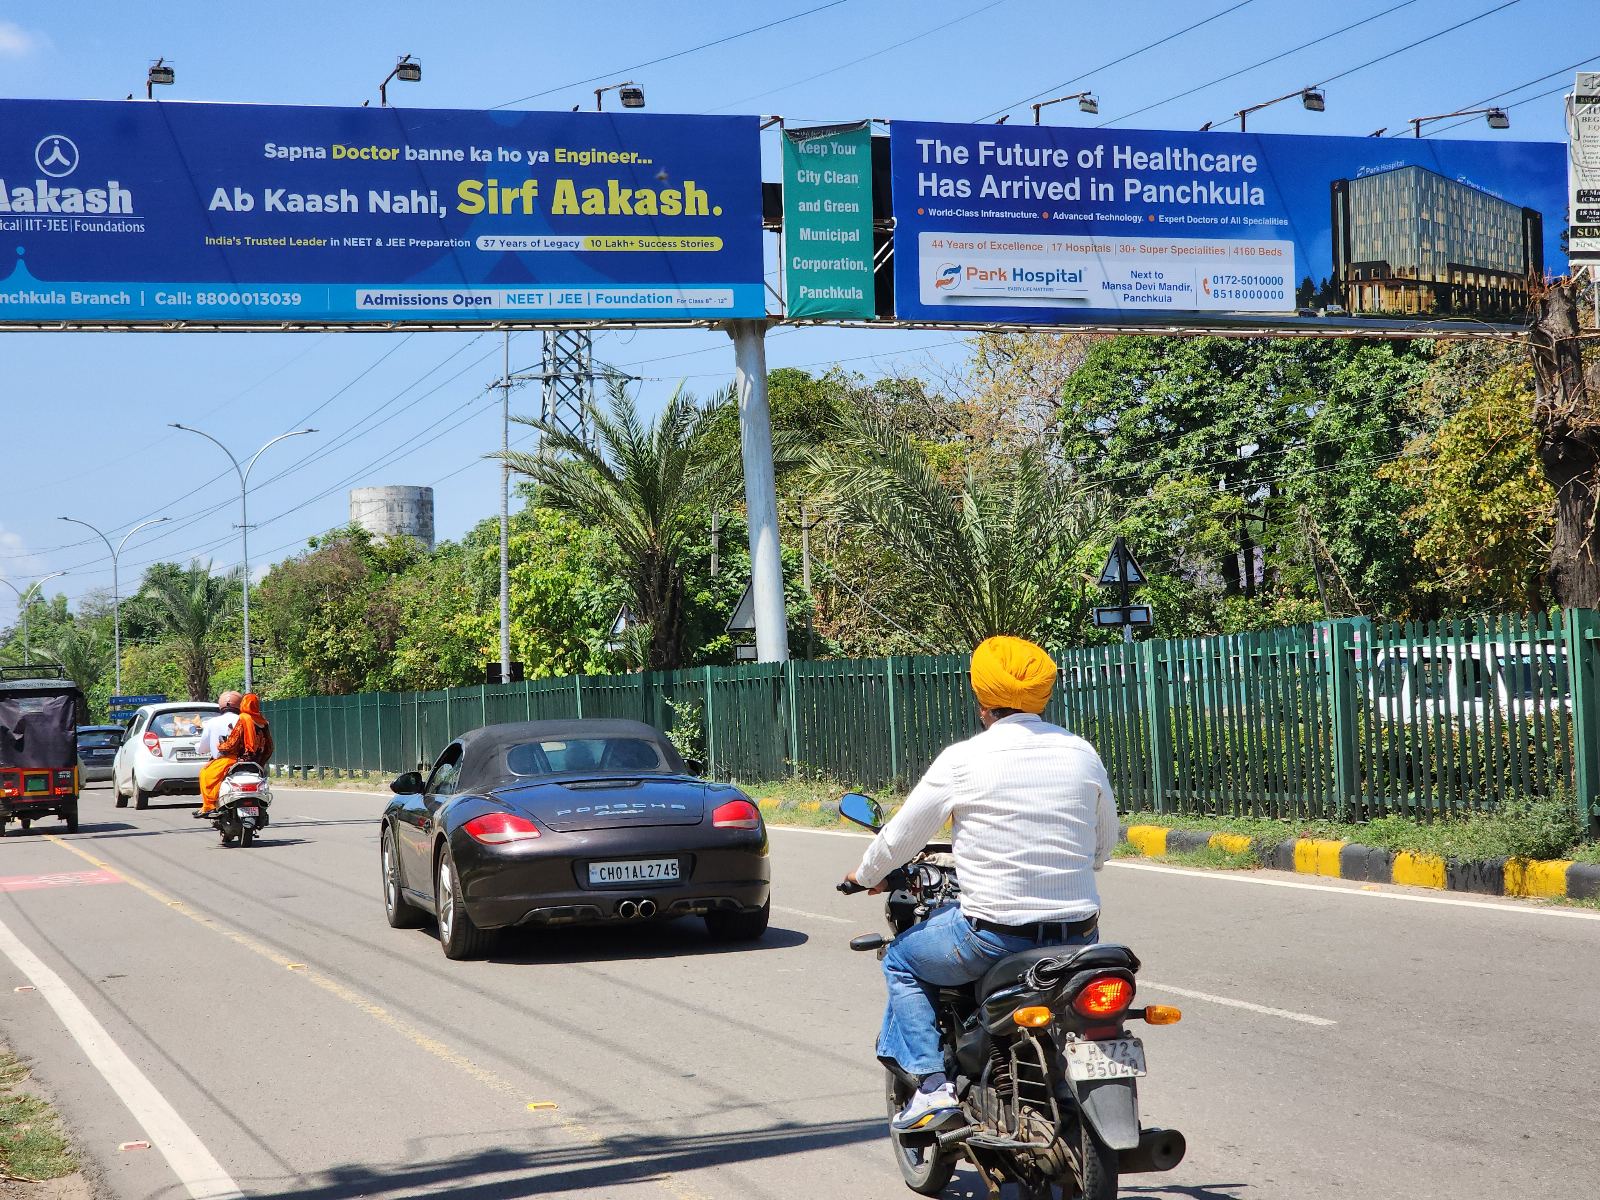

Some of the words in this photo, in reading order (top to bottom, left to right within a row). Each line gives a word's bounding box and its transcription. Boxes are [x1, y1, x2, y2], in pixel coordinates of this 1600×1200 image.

[264, 142, 326, 162] Sapna
[332, 144, 400, 161] Doctor
[405, 145, 464, 162] banne
[470, 146, 493, 162] ka
[498, 147, 522, 163] ho
[527, 151, 549, 165] ya
[554, 148, 652, 166] Engineer...
[798, 141, 828, 156] Keep
[830, 142, 857, 155] Your
[915, 138, 969, 165] The
[979, 141, 1068, 168] Future
[1077, 144, 1104, 169] of
[1113, 145, 1257, 173] Healthcare
[797, 170, 820, 185] City
[824, 170, 858, 184] Clean
[918, 172, 971, 198] Has
[980, 173, 1080, 201] Arrived
[1090, 177, 1114, 202] in
[1124, 178, 1265, 206] Panchkula
[208, 187, 254, 212] Ab
[264, 188, 359, 213] Kaash
[369, 190, 447, 218] Nahi,
[456, 179, 539, 215] Sirf
[551, 179, 723, 216] Aakash.
[798, 200, 820, 212] and
[823, 200, 859, 213] Green
[928, 207, 979, 218] World-Class
[981, 209, 1040, 219] Infrastructure.
[1053, 211, 1093, 221] Advanced
[1096, 212, 1144, 223] Technology.
[1158, 214, 1185, 225] Expert
[1187, 215, 1219, 225] Doctors
[1220, 215, 1229, 225] of
[1230, 216, 1241, 225] All
[1243, 217, 1289, 227] Specialities
[0, 219, 19, 231] ical
[25, 219, 68, 231] IIT-JEE
[74, 220, 145, 232] Foundations
[800, 228, 860, 244] Municipal
[205, 236, 241, 246] India's
[244, 236, 286, 247] Trusted
[289, 237, 327, 247] Leader
[330, 237, 340, 247] in
[343, 237, 371, 247] NEET
[375, 237, 384, 247] &
[386, 238, 406, 248] JEE
[408, 238, 471, 250] Preparation
[483, 239, 495, 248] 37
[499, 239, 527, 248] Years
[530, 239, 541, 248] of
[544, 239, 580, 251] Legacy
[590, 239, 602, 248] 10
[605, 239, 635, 248] Lakh+
[638, 240, 676, 249] Success
[680, 240, 715, 249] Stories
[931, 240, 944, 249] 44
[946, 240, 974, 250] Years
[977, 241, 987, 250] of
[990, 241, 1043, 251] Excellence
[1052, 243, 1063, 252] 17
[1065, 243, 1111, 254] Hospitals
[1119, 244, 1136, 254] 30+
[1139, 245, 1168, 255] Super
[1170, 246, 1226, 256] Specialities
[1233, 247, 1256, 256] 4160
[1258, 247, 1282, 256] Beds
[792, 256, 868, 273] Corporation,
[966, 266, 1007, 281] Park
[1012, 267, 1083, 286] Hospital
[1130, 271, 1152, 280] Next
[1153, 271, 1164, 280] to
[1212, 275, 1284, 286] 0172-5010000
[799, 286, 864, 300] Panchkula
[1101, 282, 1133, 291] Mansa
[1135, 282, 1156, 291] Devi
[1158, 283, 1193, 293] Mandir,
[0, 290, 66, 304] nchkula
[70, 291, 131, 305] Branch
[154, 291, 192, 306] Call:
[196, 292, 302, 306] 8800013039
[362, 293, 448, 306] Admissions
[452, 294, 492, 309] Open
[506, 293, 544, 305] NEET
[557, 293, 582, 305] JEE
[596, 293, 673, 305] Foundation
[1123, 293, 1173, 303] Panchkula
[1212, 289, 1285, 300] 8518000000
[599, 862, 678, 881] CH01AL2745
